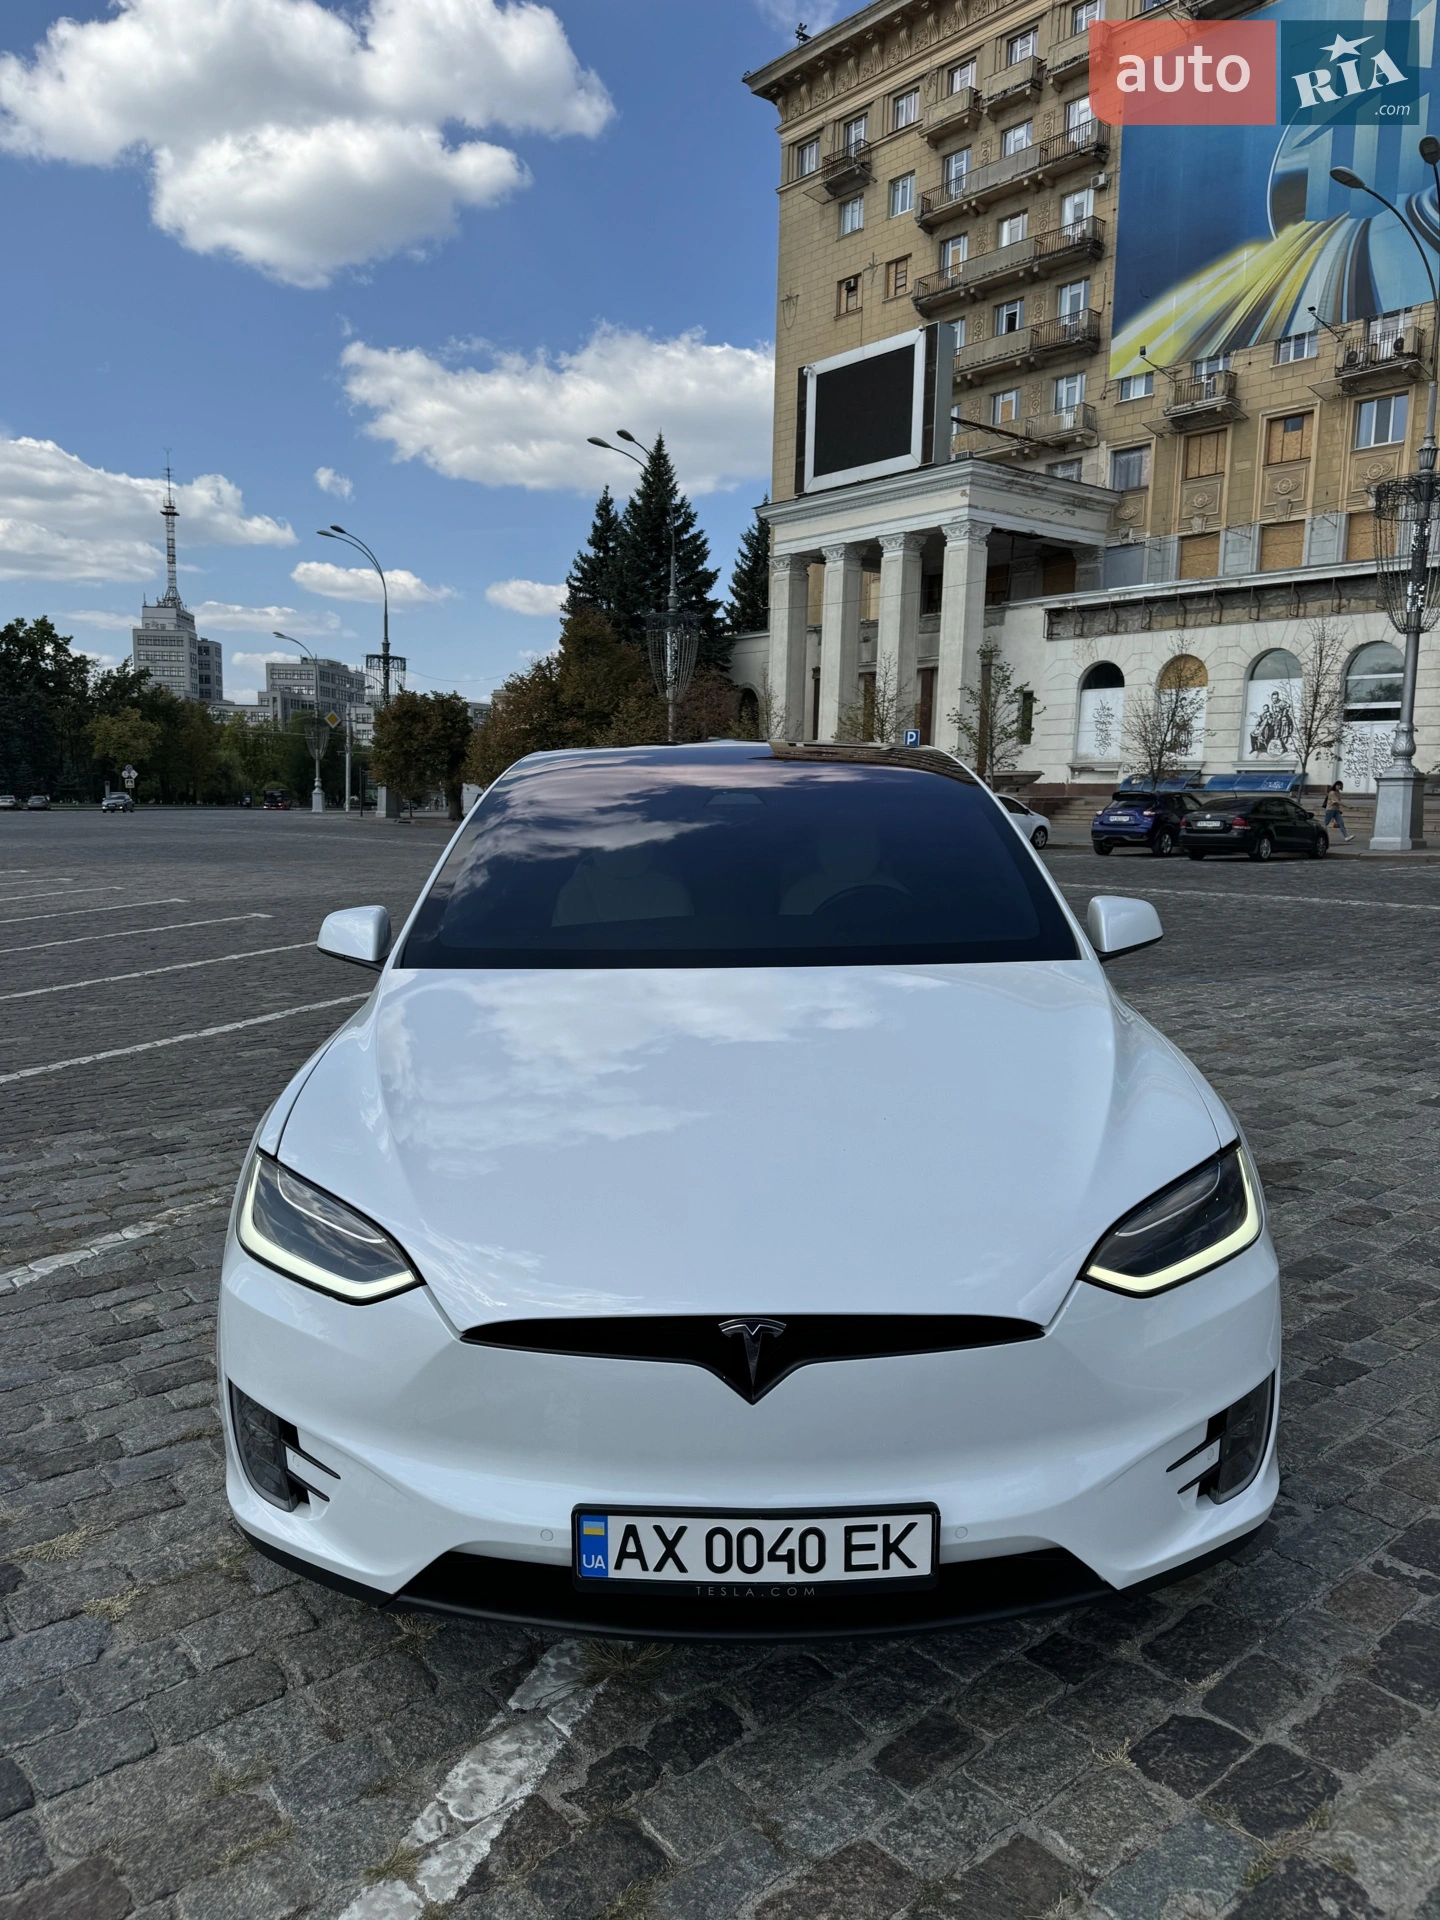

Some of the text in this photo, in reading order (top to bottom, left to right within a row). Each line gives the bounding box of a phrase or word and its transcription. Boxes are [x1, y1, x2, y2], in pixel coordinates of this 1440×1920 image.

[907, 731, 917, 745] P
[613, 1521, 919, 1575] AX 0040 EK
[582, 1554, 606, 1570] UA
[695, 1586, 816, 1598] TESLA.COM
